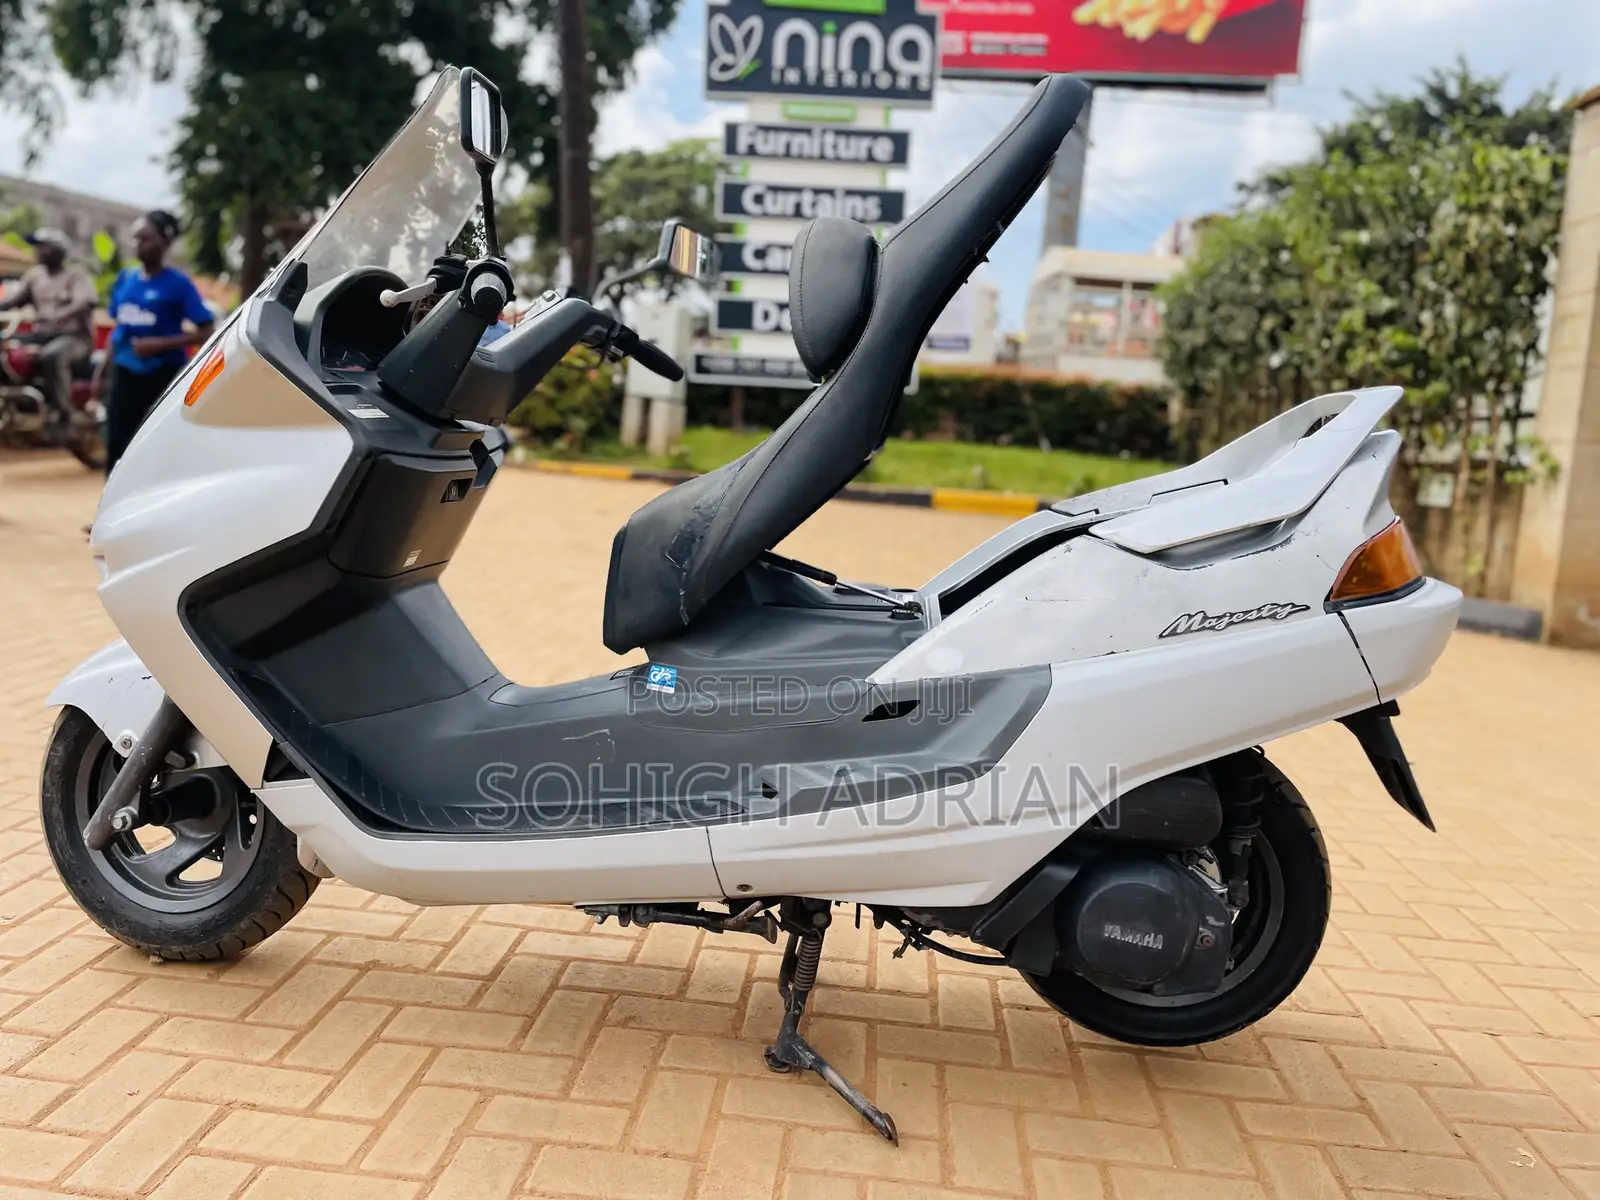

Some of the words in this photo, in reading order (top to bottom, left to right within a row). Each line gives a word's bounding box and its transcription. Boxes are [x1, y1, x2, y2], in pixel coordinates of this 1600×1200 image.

[771, 18, 933, 75] nina
[736, 124, 894, 162] Furniture
[741, 185, 882, 221] Curtains
[1160, 604, 1307, 637] Majesty
[1104, 925, 1164, 949] YAMAHA
